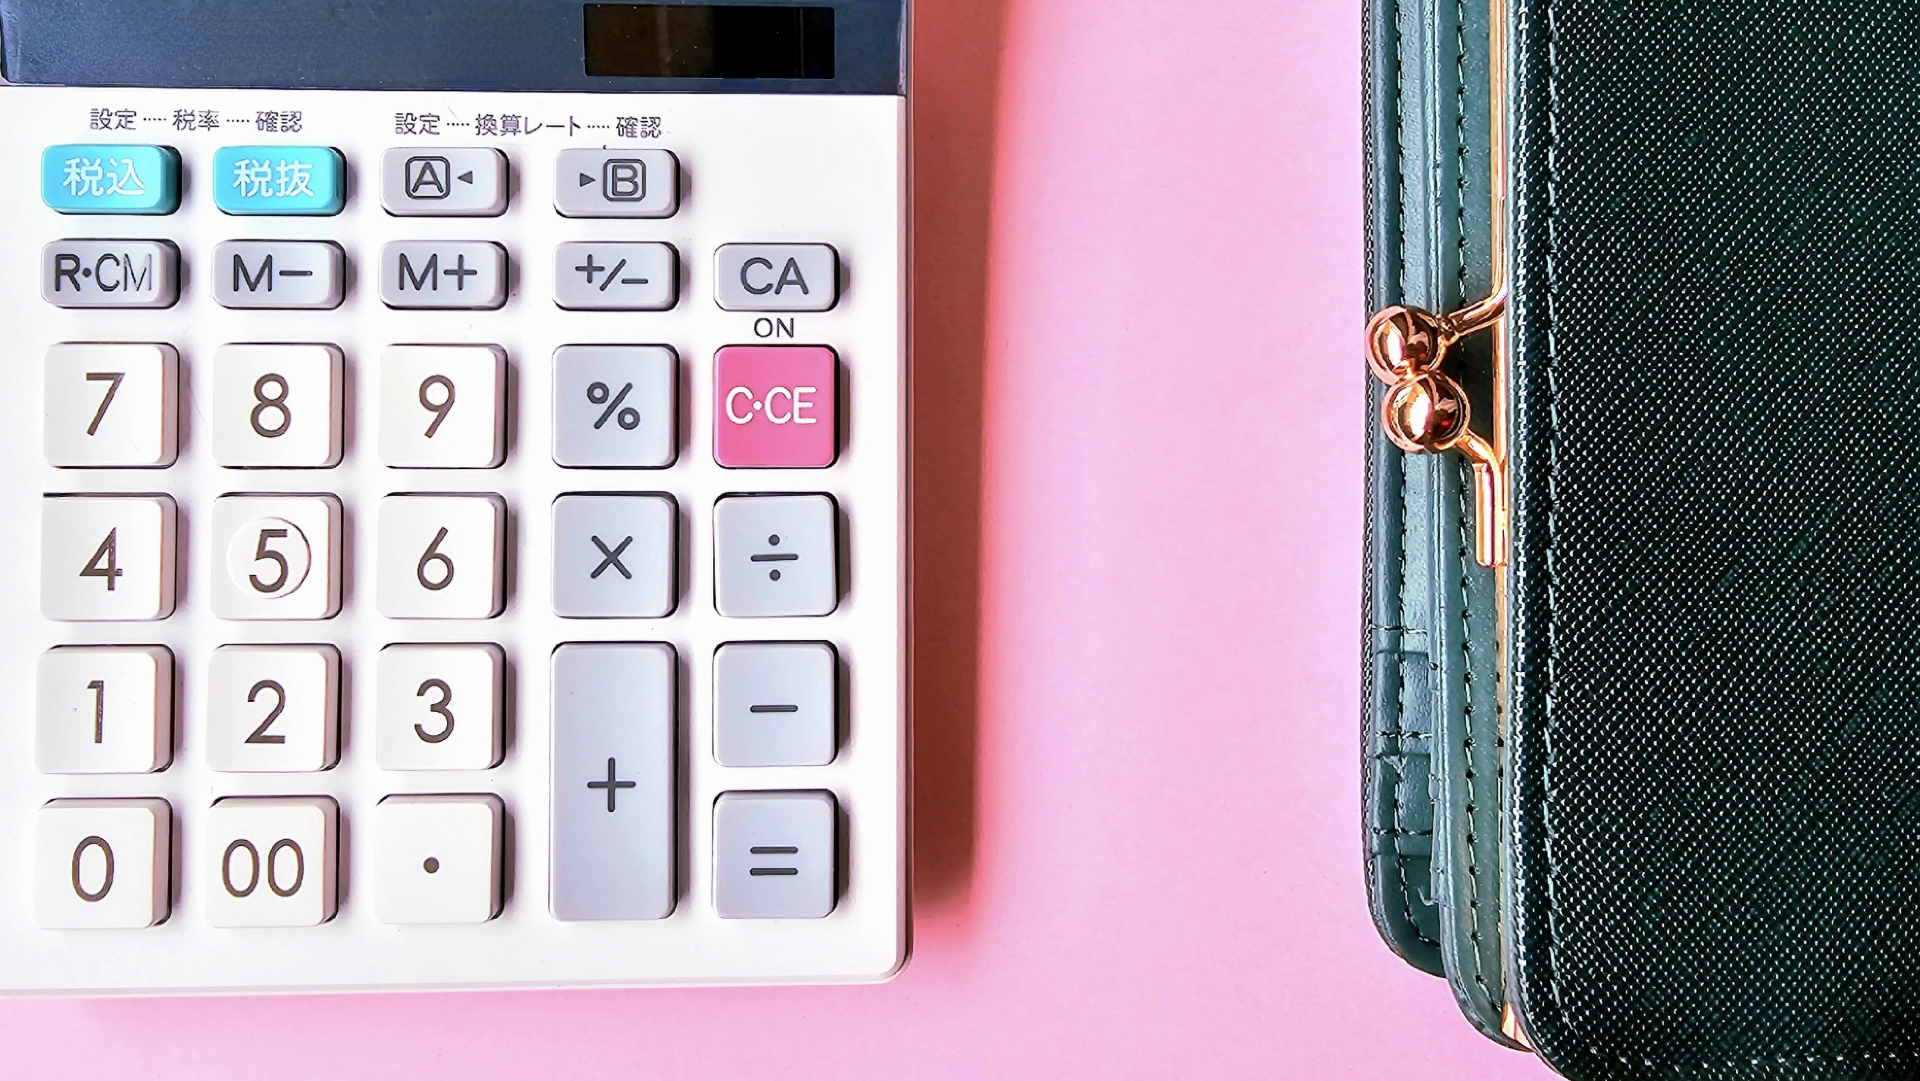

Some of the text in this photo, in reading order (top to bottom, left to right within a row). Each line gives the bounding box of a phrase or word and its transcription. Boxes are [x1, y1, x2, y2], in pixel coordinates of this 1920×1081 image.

[90, 108, 303, 133] 設定 税率 確認
[394, 112, 662, 139] 設定 換算レート 確認
[63, 158, 146, 196] 税込
[232, 159, 314, 197] 税抜
[411, 161, 444, 195] A
[612, 163, 639, 197] B
[398, 252, 478, 292] M+
[740, 256, 810, 296] CA
[753, 317, 794, 339] ON
[86, 372, 125, 437] 7
[250, 372, 292, 439] 8
[418, 374, 456, 439] 9
[586, 381, 641, 431] %
[78, 526, 123, 591] 4
[249, 528, 289, 594] 5
[416, 526, 455, 591] 6
[86, 680, 105, 744] 1
[244, 679, 286, 745] 2
[413, 678, 455, 744] 3
[586, 757, 637, 813] +
[71, 835, 115, 903] 0
[221, 838, 305, 898] 00
[749, 846, 799, 877] =
